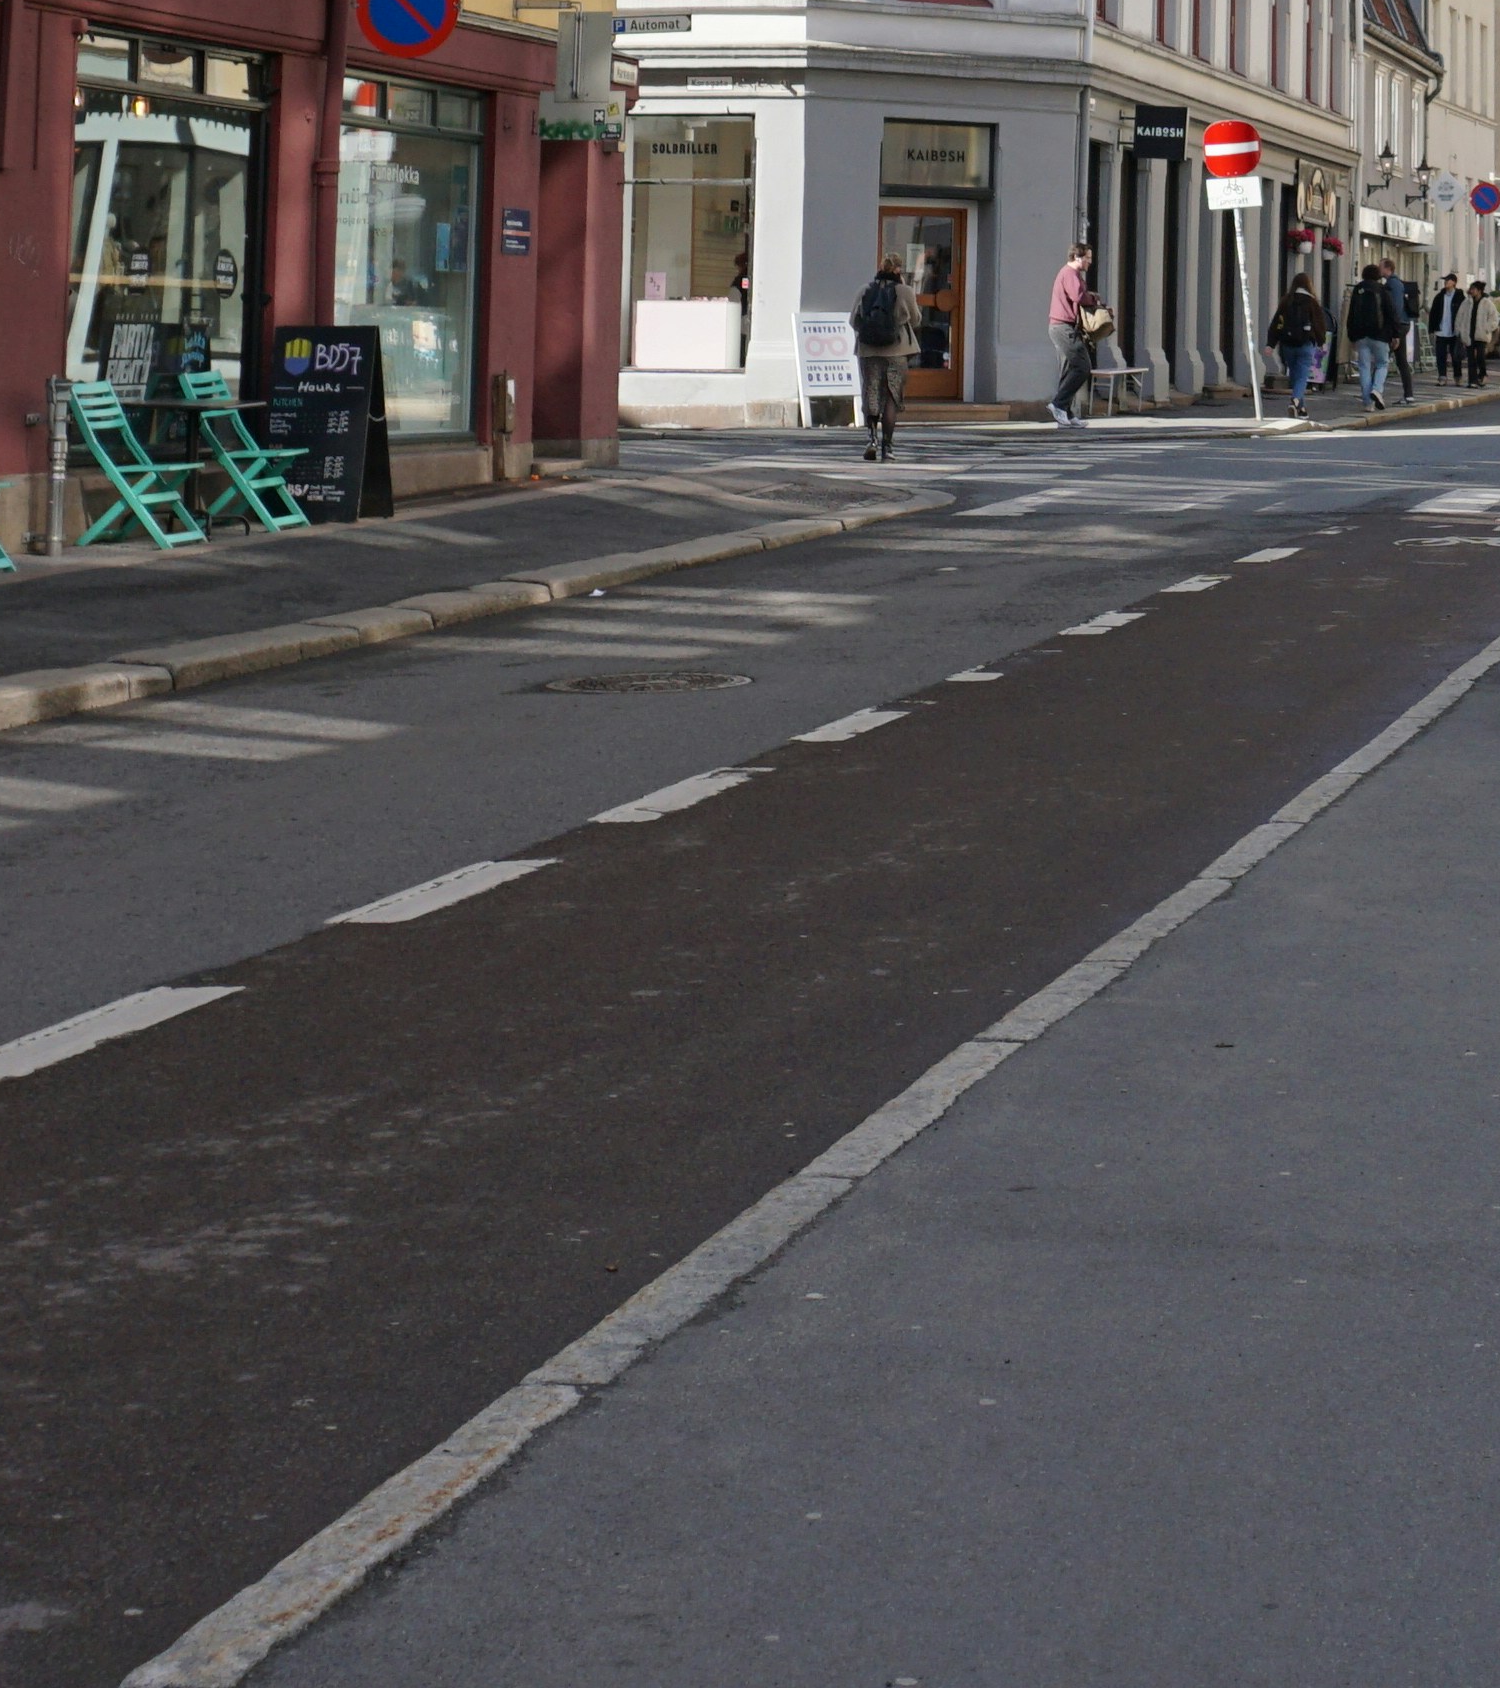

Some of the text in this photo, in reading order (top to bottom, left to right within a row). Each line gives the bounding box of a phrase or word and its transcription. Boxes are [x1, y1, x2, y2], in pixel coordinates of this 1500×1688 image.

[630, 19, 680, 31] Automat
[1136, 125, 1184, 139] KAIBOSH
[652, 142, 718, 155] SOLBRILLER
[907, 148, 966, 162] KAIBOSH
[314, 343, 362, 376] BD57
[807, 372, 852, 382] DESIGN
